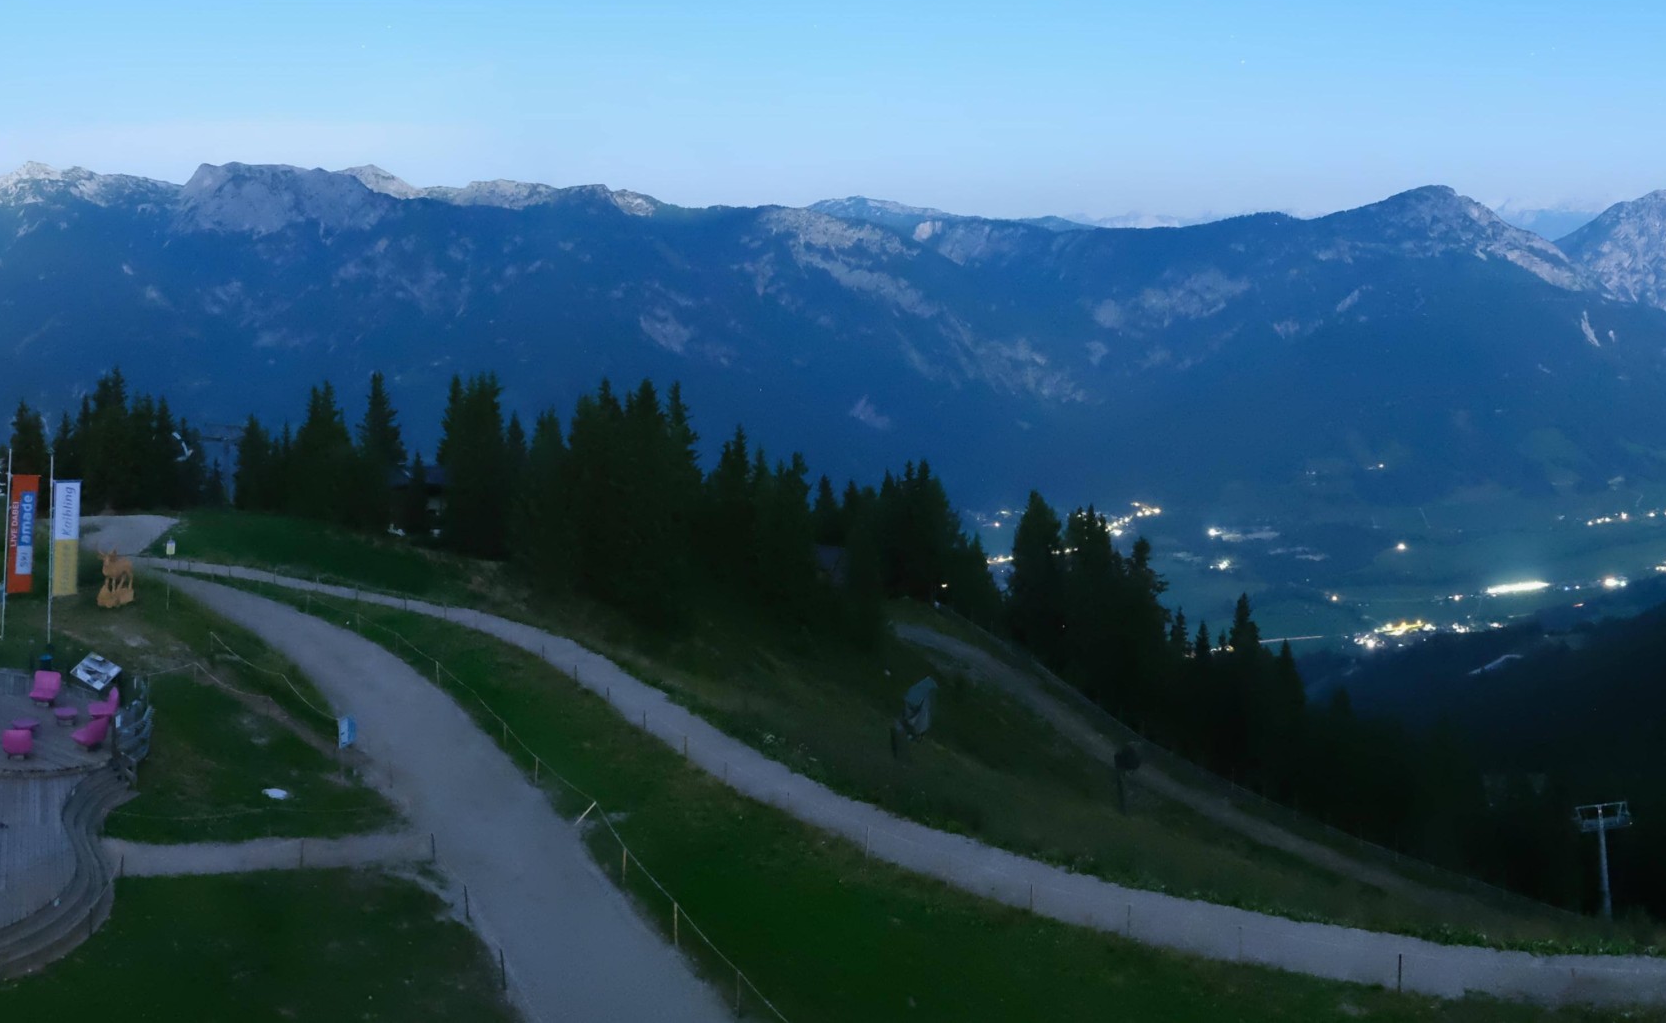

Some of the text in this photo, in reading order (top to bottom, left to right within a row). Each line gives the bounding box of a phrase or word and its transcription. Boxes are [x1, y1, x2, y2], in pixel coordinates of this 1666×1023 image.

[10, 501, 20, 547] LIVE DABEI
[62, 486, 76, 537] Kaibling
